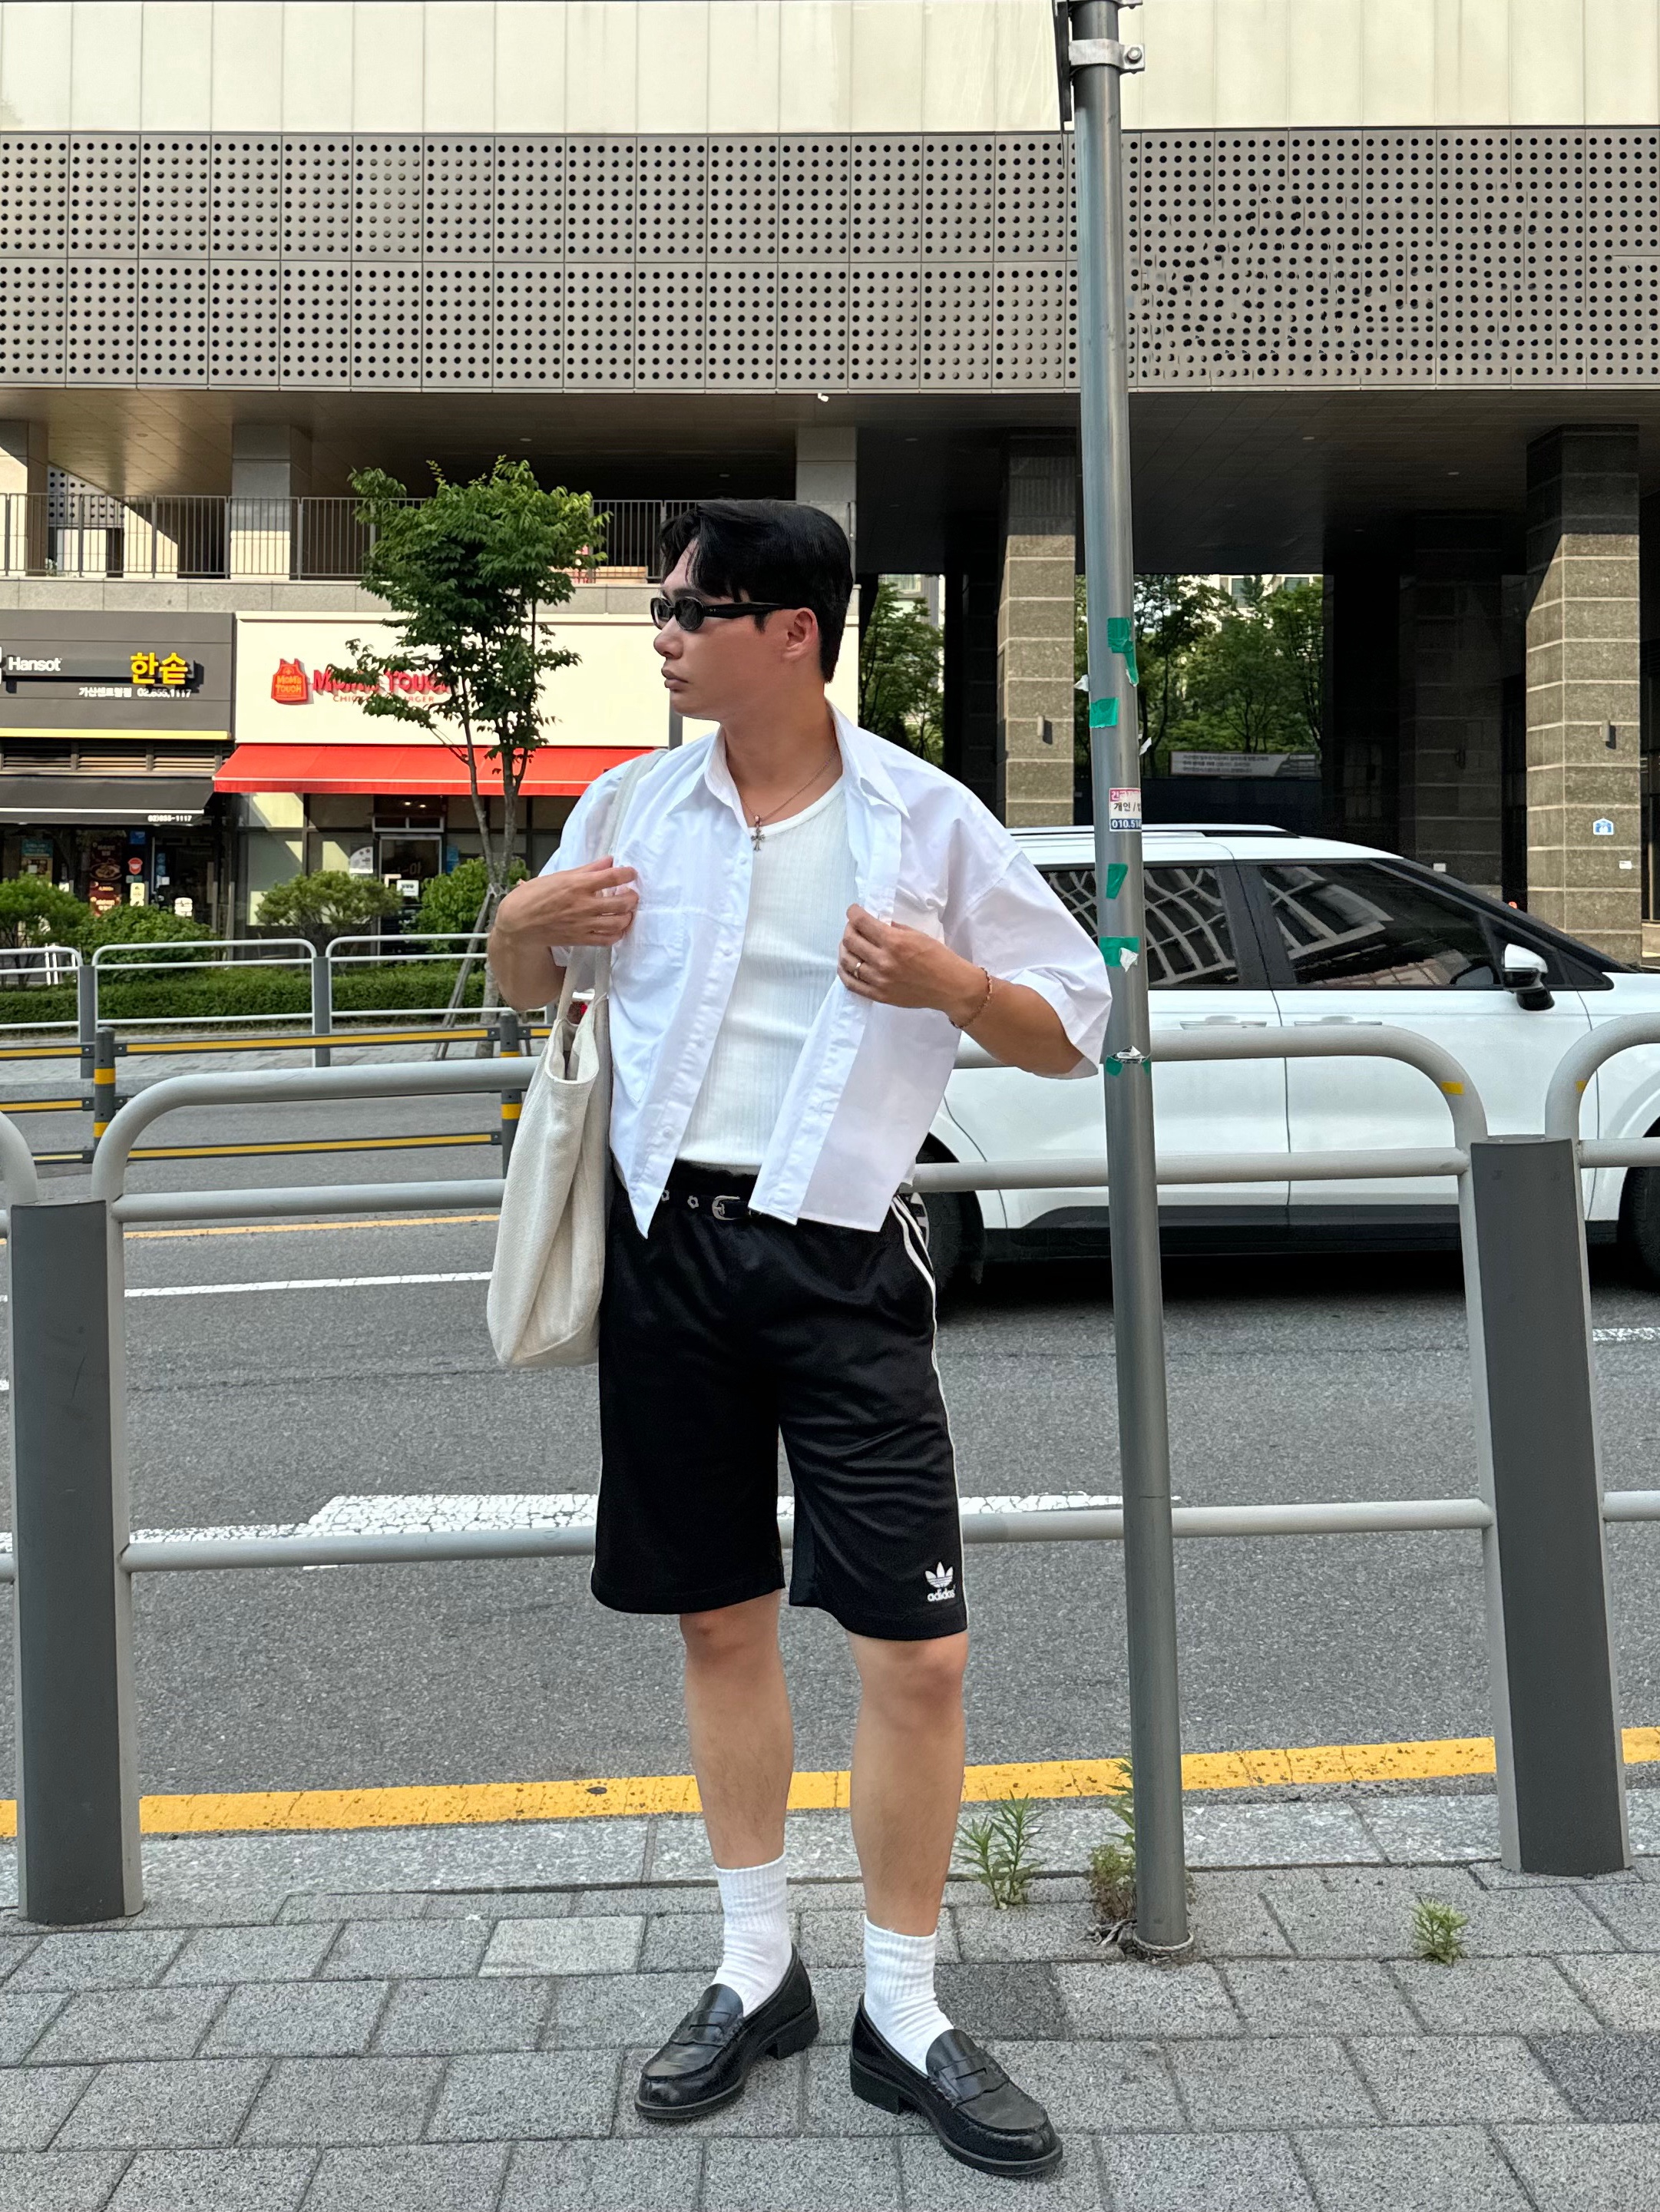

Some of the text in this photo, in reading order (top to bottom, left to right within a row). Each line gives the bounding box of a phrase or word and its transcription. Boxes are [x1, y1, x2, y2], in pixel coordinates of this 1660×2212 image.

[8, 656, 61, 672] Hansot
[130, 652, 189, 685] 한솥
[927, 1587, 956, 1602] adidas
